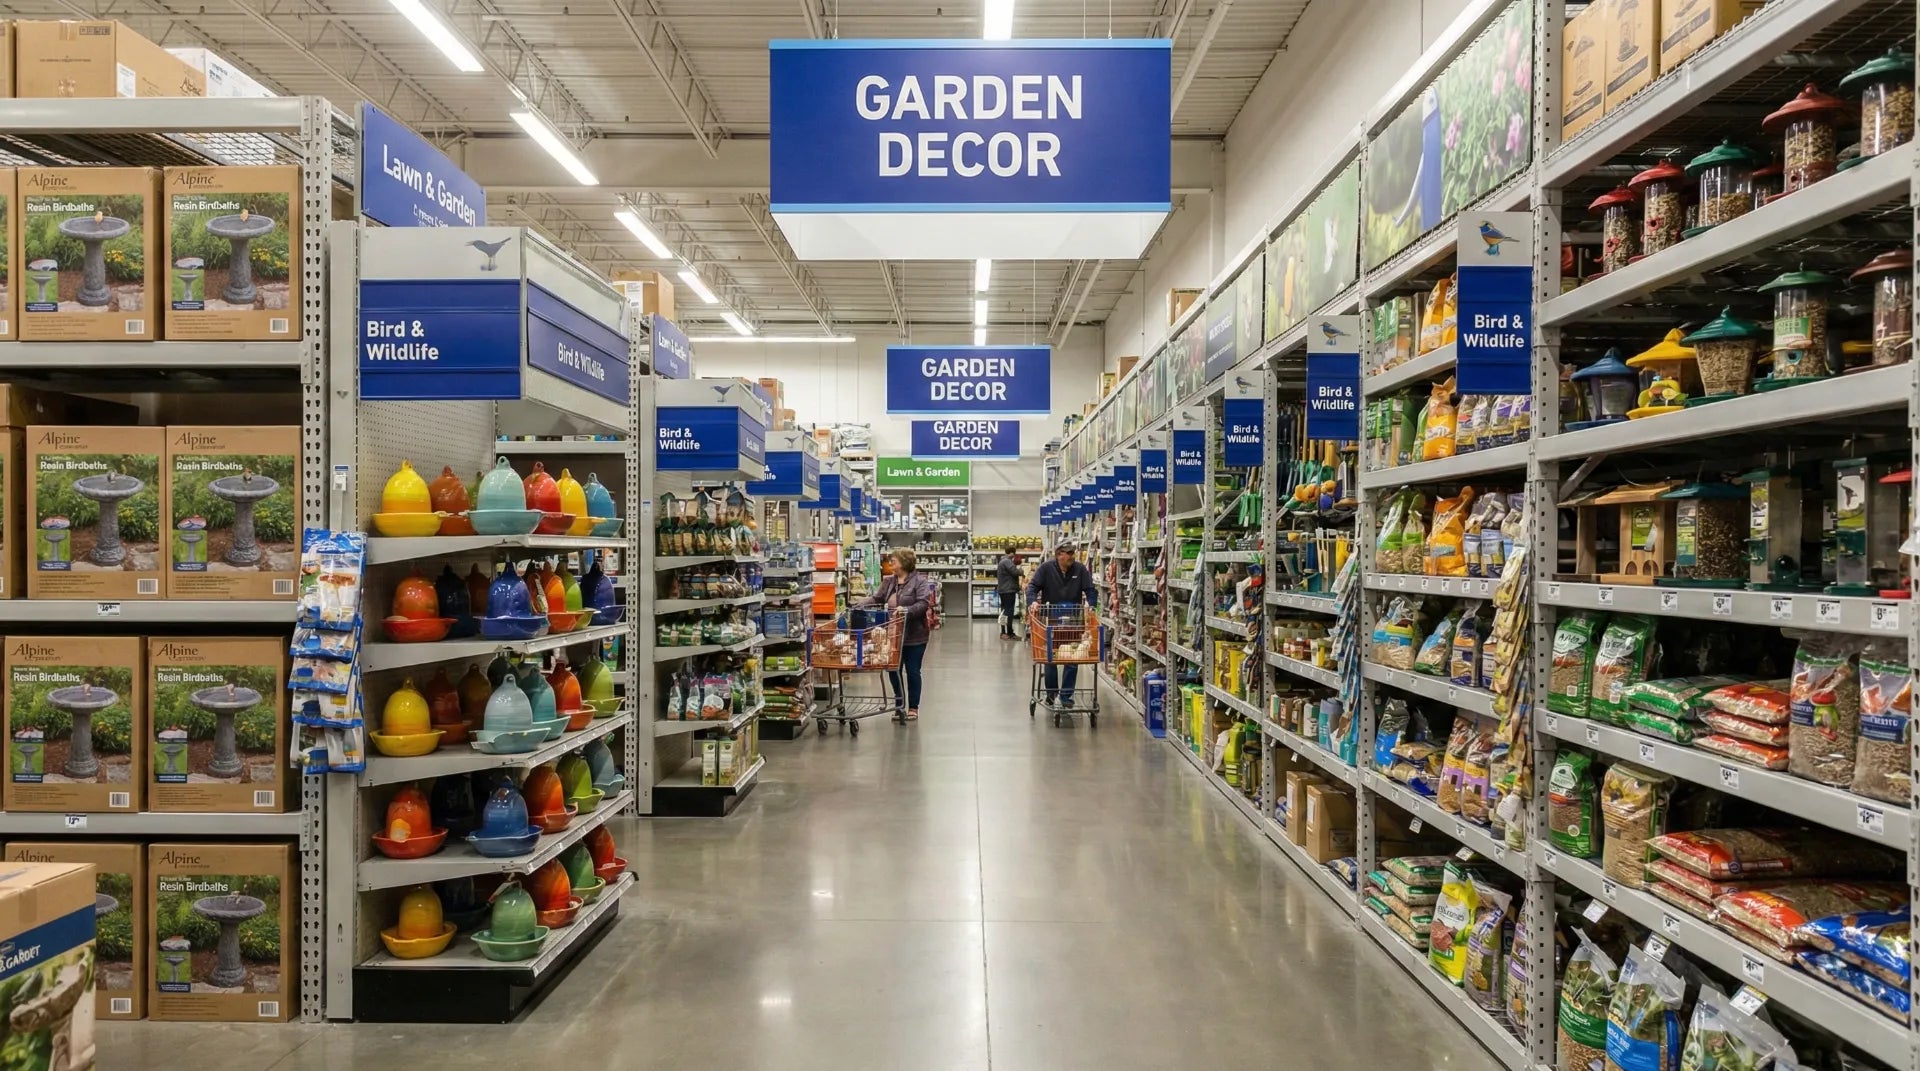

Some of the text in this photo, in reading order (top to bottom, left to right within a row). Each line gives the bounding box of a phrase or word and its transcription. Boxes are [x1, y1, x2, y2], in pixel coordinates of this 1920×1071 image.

[855, 75, 1082, 120] GARDEN
[879, 132, 1062, 177] DECOR
[27, 173, 68, 191] Alpine
[383, 144, 422, 193] Lawn
[426, 171, 435, 201] &
[438, 180, 476, 227] Garden
[27, 203, 51, 212] Resin
[173, 201, 198, 210] Resin
[366, 320, 424, 337] Bird &
[1474, 314, 1524, 329] Bird &
[1463, 333, 1525, 348] Wildlife
[366, 343, 439, 361] Wildlife
[558, 341, 573, 367] Bird
[574, 350, 580, 370] &
[921, 358, 1015, 377] GARDEN
[930, 381, 1007, 401] DECOR
[1318, 386, 1353, 397] Bird &
[1311, 399, 1355, 410] Wildlife
[659, 427, 692, 438] Bird &
[933, 421, 999, 434] GARDEN
[1233, 425, 1259, 433] Bird &
[38, 432, 81, 450] Alpine
[174, 432, 216, 450] Alpine
[659, 439, 701, 450] Wildlife
[939, 437, 992, 450] DECOR
[1227, 435, 1260, 443] Wildlife
[1180, 450, 1202, 458] Bird &
[202, 461, 244, 471] Birdbaths
[887, 467, 961, 477] Lawn & Garden
[10, 643, 55, 658] Alpine
[156, 643, 199, 659] Alpine
[13, 672, 37, 682] Resin
[157, 672, 224, 682] Resin Birdbaths
[159, 851, 201, 869] Alpine
[160, 881, 229, 892] Resin Birdbaths
